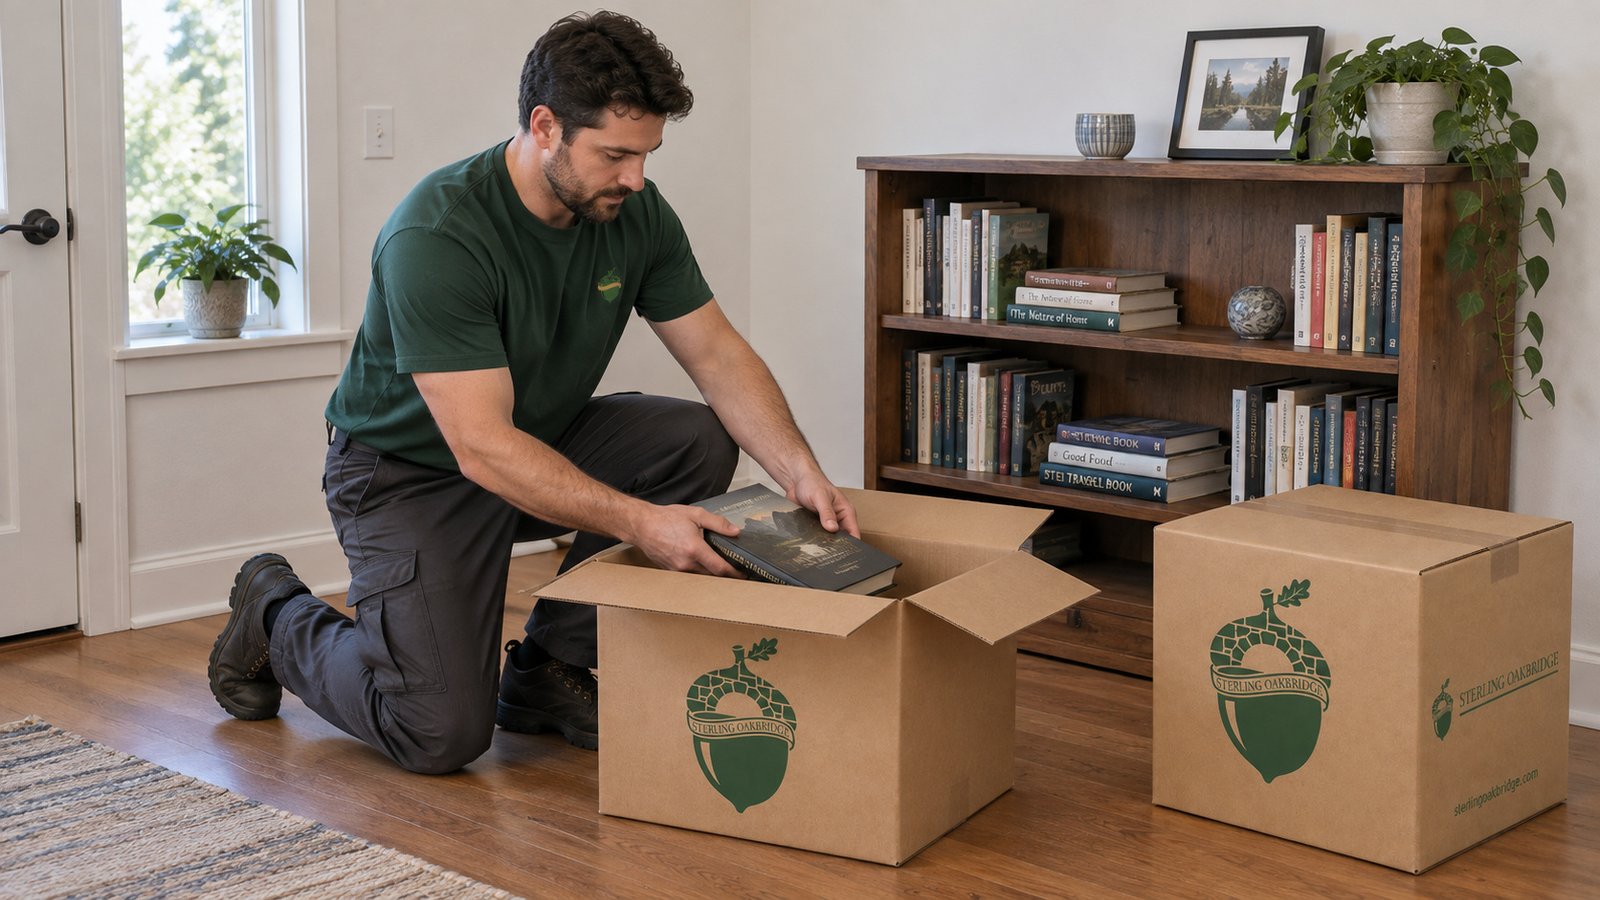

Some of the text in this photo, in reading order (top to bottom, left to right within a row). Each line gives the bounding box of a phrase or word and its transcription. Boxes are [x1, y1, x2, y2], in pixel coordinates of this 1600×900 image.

[1055, 312, 1064, 323] of
[1113, 436, 1139, 449] BOOK
[1062, 450, 1113, 467] Good Food
[1105, 478, 1133, 493] BOOK
[1216, 677, 1323, 696] STERLING OAKBRIDGE
[1459, 651, 1559, 708] STERLING OAKBRIDGE
[692, 721, 790, 737] STERLING OAKBRIDGE
[1453, 768, 1539, 817] sterlingoakbridge.com
